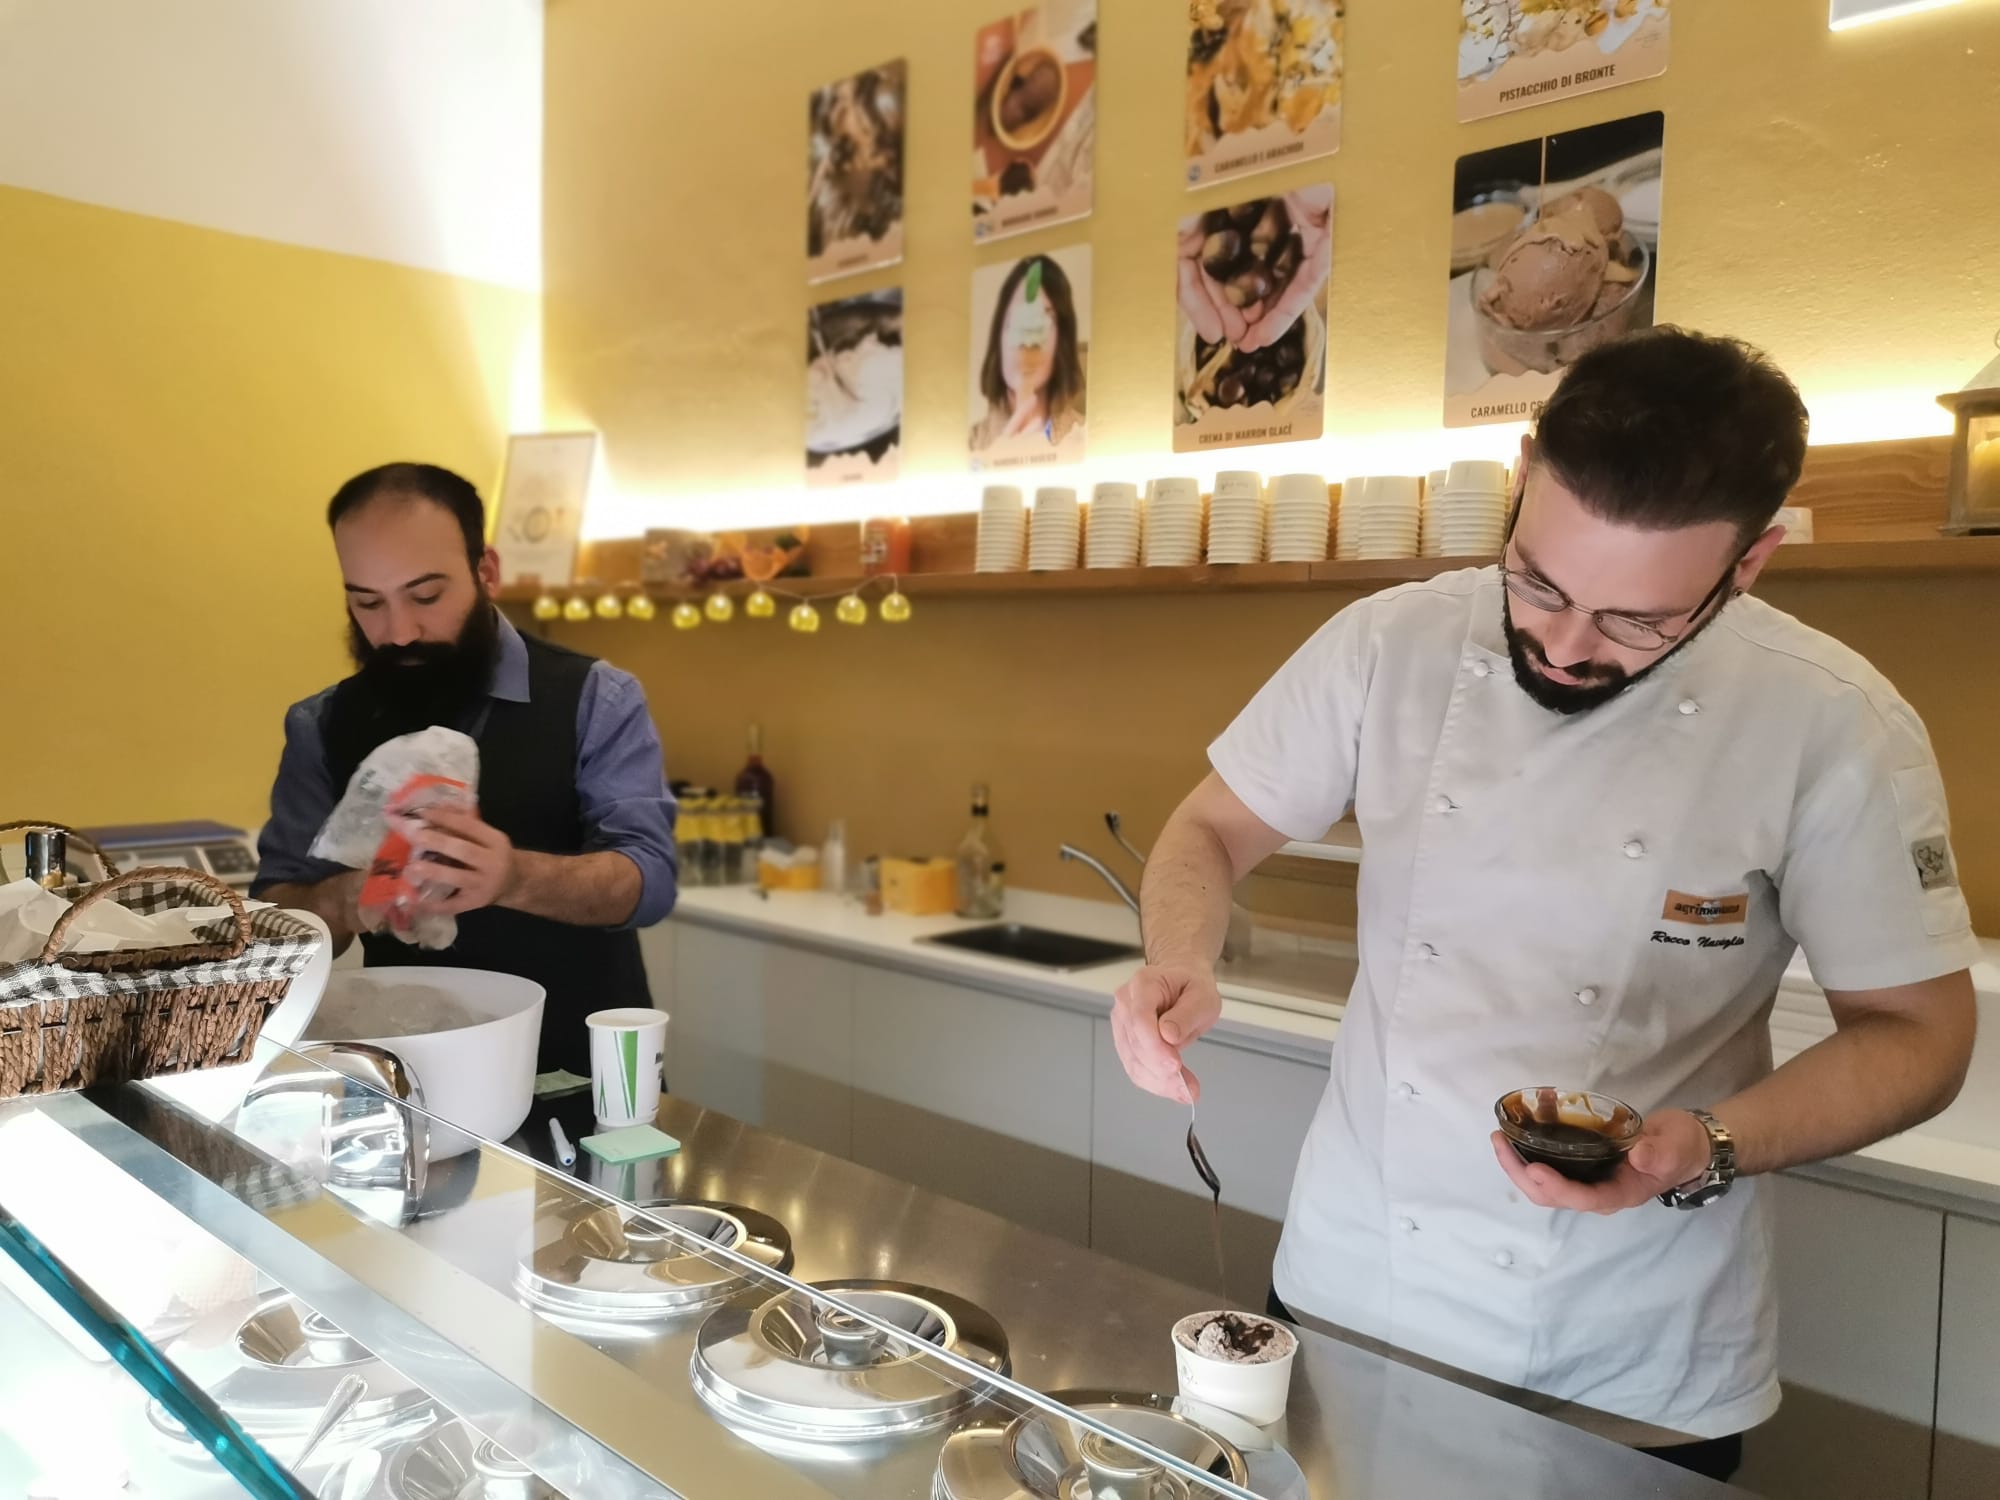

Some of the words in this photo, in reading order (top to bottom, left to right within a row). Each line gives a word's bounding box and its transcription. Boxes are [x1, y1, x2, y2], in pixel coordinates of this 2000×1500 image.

[1499, 78, 1558, 103] PISTACCHIO
[1561, 74, 1572, 88] DI
[1575, 64, 1616, 85] BRONTE
[1471, 402, 1527, 418] CARAMELLO
[1199, 432, 1223, 444] CREMA
[1650, 930, 1690, 946] Rocco
